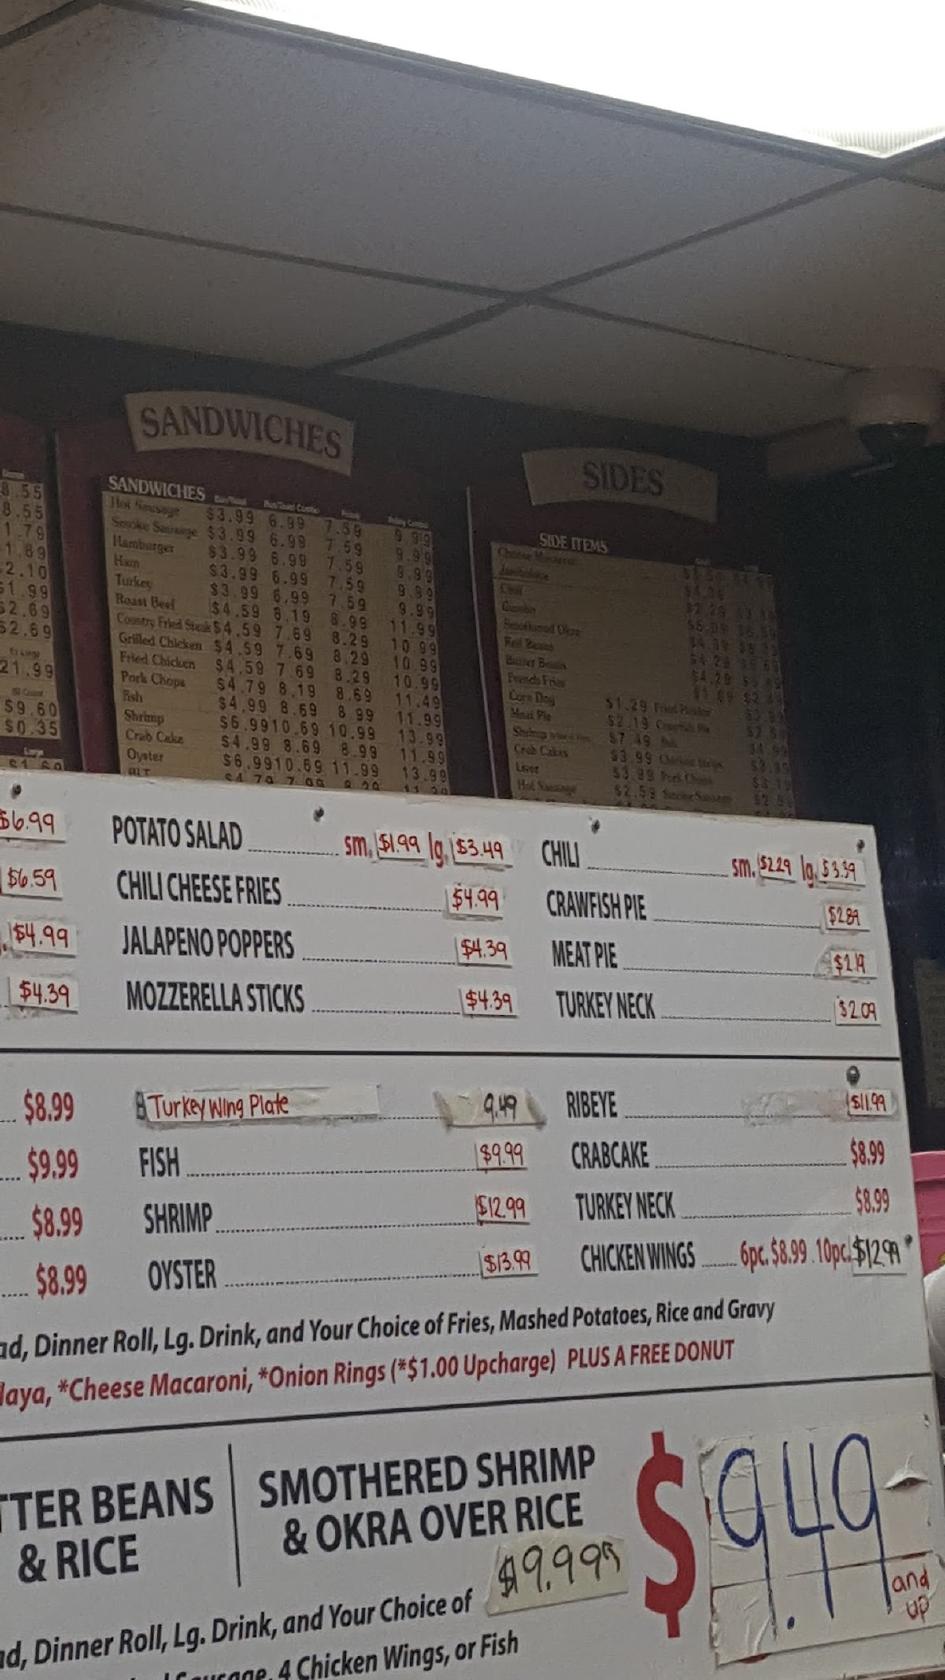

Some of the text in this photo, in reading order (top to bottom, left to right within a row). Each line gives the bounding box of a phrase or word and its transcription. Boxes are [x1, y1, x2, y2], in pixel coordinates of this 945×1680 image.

[140, 405, 341, 459] SANDWICHES
[108, 475, 205, 501] SANDWICHES
[583, 461, 664, 496] SIDES
[112, 534, 175, 554] Hamburger
[539, 532, 608, 554] SIDE ITEMS
[115, 573, 152, 589] Turkey
[119, 632, 202, 651] Grilled Chicken
[120, 651, 196, 670] Fried Chicken
[121, 671, 186, 688] Pork Chops
[124, 709, 165, 725] Shrimp
[126, 729, 184, 745] Crab Cake
[127, 748, 164, 763] Oyster
[0, 809, 55, 835] $6.99
[112, 815, 373, 859] POTATO SALAD sm.
[378, 833, 420, 854] $1.99
[428, 832, 449, 867] lg.
[456, 839, 504, 859] $3.49
[541, 838, 756, 879] CHILI sm.
[7, 866, 57, 890] $6.59
[116, 870, 282, 905] CHILI CHEESE FRIES
[800, 858, 818, 889] lg.
[452, 882, 498, 911] $4.99
[546, 889, 647, 921] CRAWFISH PIE
[13, 923, 69, 949] $4.99
[122, 924, 295, 960] JALAPENO POPPERS
[460, 938, 508, 961] $4.39
[552, 940, 618, 970] MEAT PIE
[18, 981, 71, 1007] $4.39
[126, 980, 305, 1014] MOZZERELLA STICKS
[465, 990, 512, 1012] $4.39
[555, 990, 655, 1021] TURKEY NECK
[23, 1088, 75, 1124] $8.99
[147, 1092, 206, 1122] Turkey
[209, 1094, 244, 1122] Wing
[248, 1092, 290, 1116] Plate
[483, 1092, 518, 1120] 9.49
[566, 1090, 618, 1119] RIBEYE
[850, 1092, 887, 1112] $11.99
[27, 1146, 79, 1181] $9.99
[139, 1146, 180, 1178] FISH
[479, 1142, 524, 1167] $9.99
[571, 1138, 885, 1169] CRABCAKE $8.99
[143, 1202, 213, 1234] SHRIMP
[476, 1194, 526, 1220] $12.99
[575, 1187, 890, 1220] TURKEY NECK $8.99
[31, 1203, 83, 1240] $8.99
[483, 1250, 531, 1274] $13.99
[581, 1235, 851, 1274] CHICKEN WINGS 6pc. $8.99 10pc.
[35, 1262, 88, 1299] $8.99
[148, 1259, 217, 1290] OYSTER
[34, 1330, 109, 1357] Dinner
[113, 1326, 160, 1356] Roll,
[163, 1325, 194, 1357] Lg.
[198, 1320, 261, 1350] Drink,
[266, 1318, 304, 1345] and
[308, 1316, 353, 1342] Your
[356, 1313, 420, 1340] Choice
[424, 1312, 445, 1334] of
[447, 1309, 495, 1336] Fries,
[499, 1304, 569, 1332] Mashed
[572, 1301, 652, 1327] Potatoes,
[656, 1299, 689, 1324] Rice
[693, 1298, 724, 1321] and
[727, 1299, 775, 1324] Gravy
[150, 1367, 255, 1399] Macaroni,
[333, 1360, 386, 1391] Rings
[463, 1348, 556, 1381] Upcharge)
[567, 1345, 611, 1370] PLUS
[614, 1344, 628, 1368] A
[630, 1342, 671, 1366] FREE
[674, 1339, 735, 1364] DONUT
[258, 1445, 596, 1508] SMOTHERED SHRIMP
[91, 1476, 214, 1524] BEANS
[282, 1491, 584, 1556] & OKRA OVER RICE
[18, 1534, 139, 1583] & RICE
[892, 1567, 930, 1593] and
[907, 1596, 930, 1623] up
[34, 1637, 113, 1665] Dinner
[119, 1624, 167, 1654] Roll,
[173, 1622, 206, 1652] Lg.
[212, 1612, 278, 1643] Drink,
[283, 1605, 323, 1635] and
[329, 1602, 375, 1627] Your
[380, 1595, 447, 1622] Choice
[452, 1588, 473, 1612] of
[279, 1659, 291, 1680] 4
[297, 1650, 378, 1680] Chicken
[383, 1642, 450, 1672] Wings,
[455, 1641, 474, 1660] or
[481, 1630, 518, 1657] Fish
